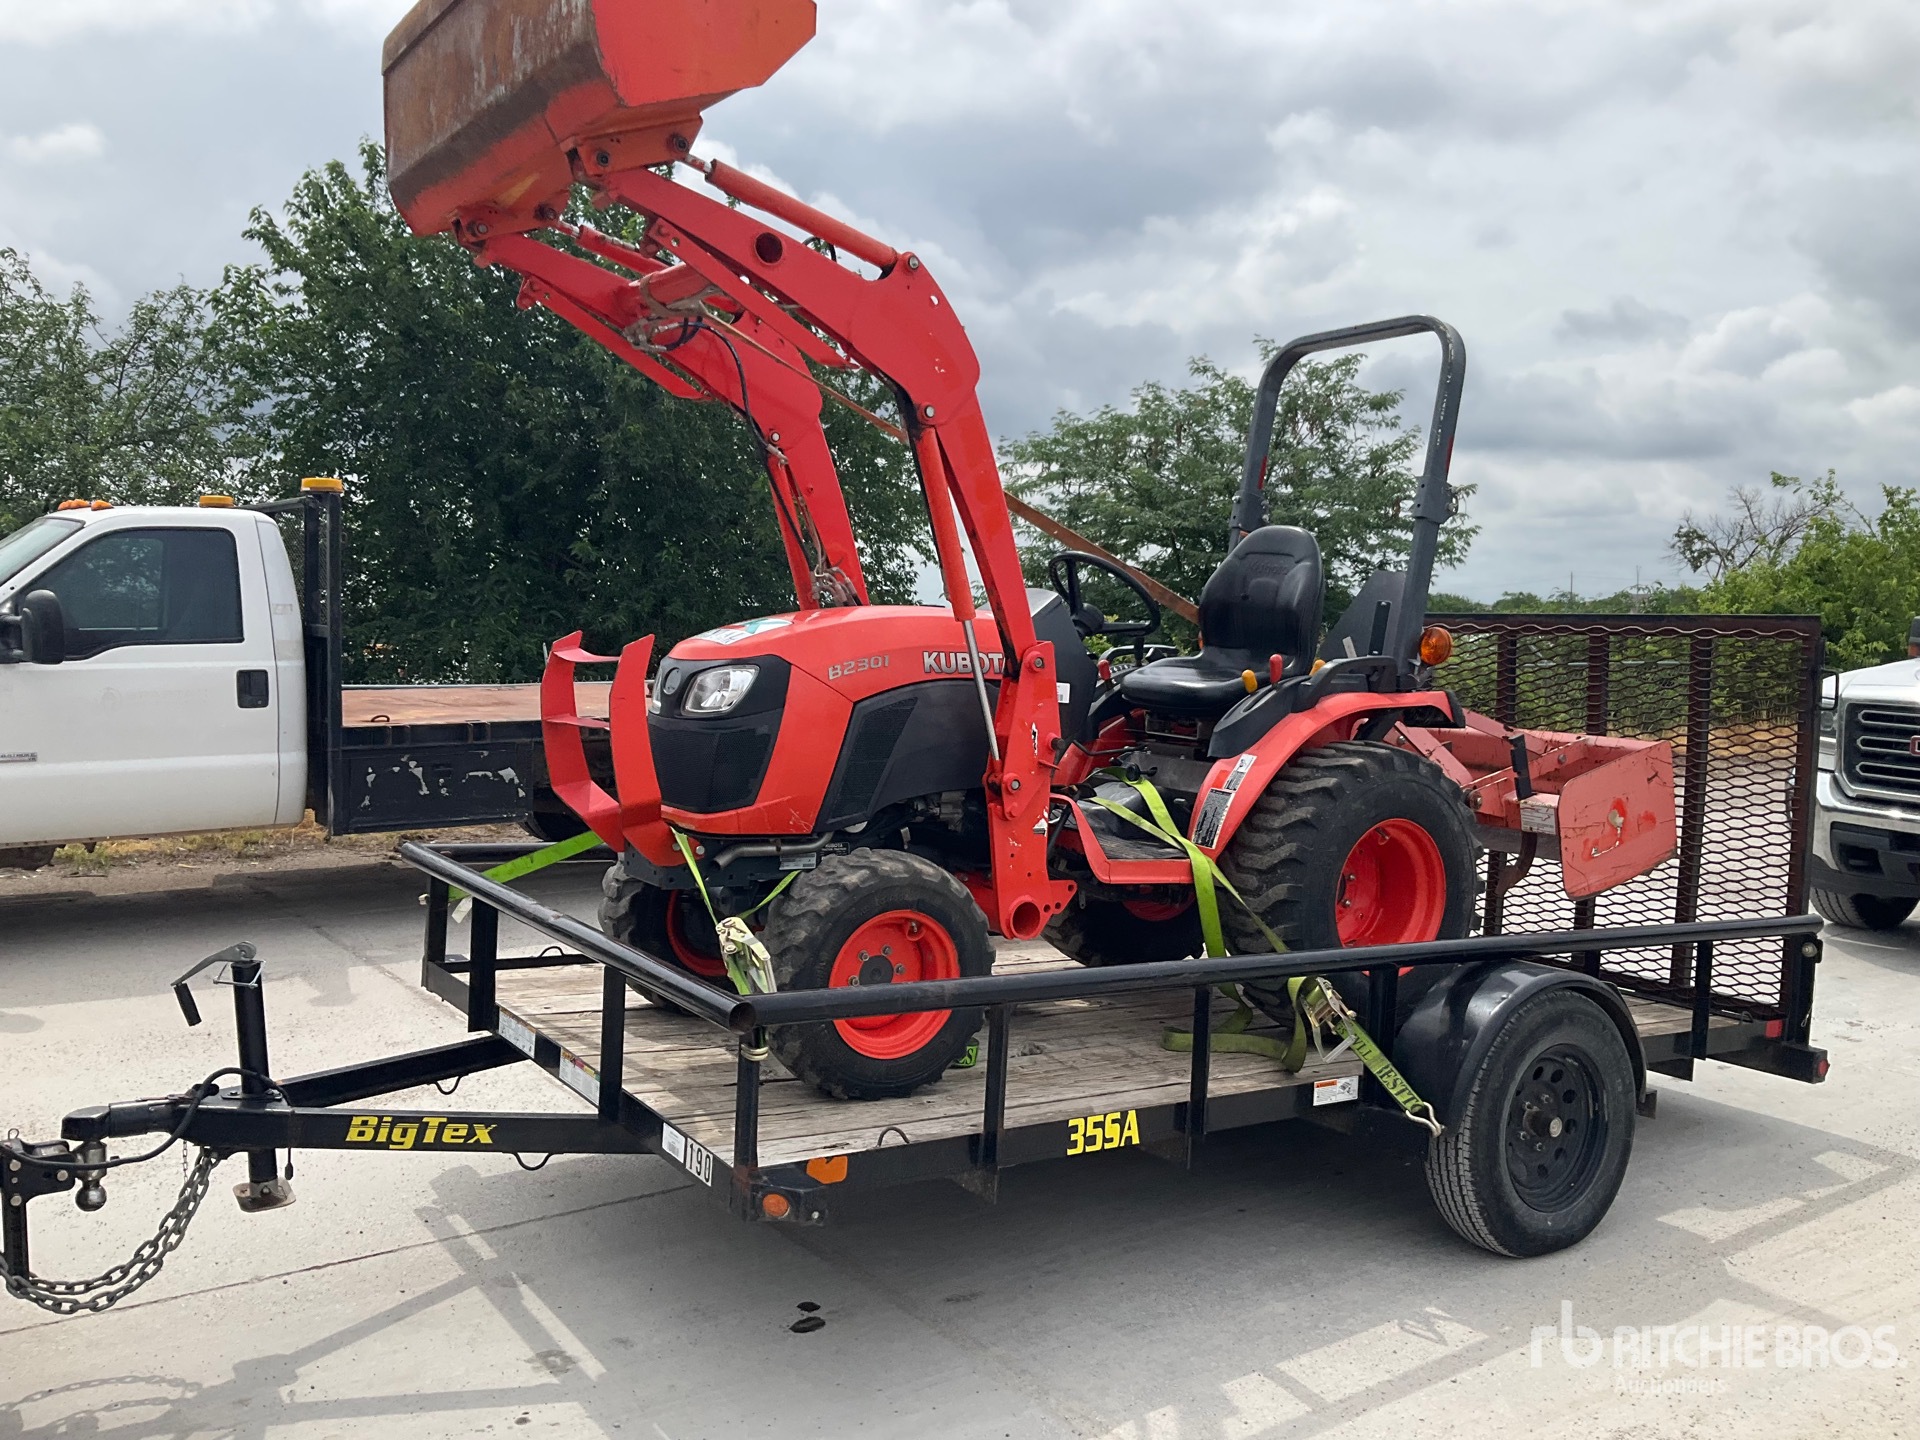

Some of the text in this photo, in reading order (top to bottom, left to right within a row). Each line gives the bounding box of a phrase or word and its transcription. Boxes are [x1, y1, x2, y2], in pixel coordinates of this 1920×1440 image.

[828, 655, 890, 681] B2301
[922, 651, 1006, 674] KUBOT
[1066, 1109, 1140, 1156] 35SA
[689, 1142, 711, 1183] 190
